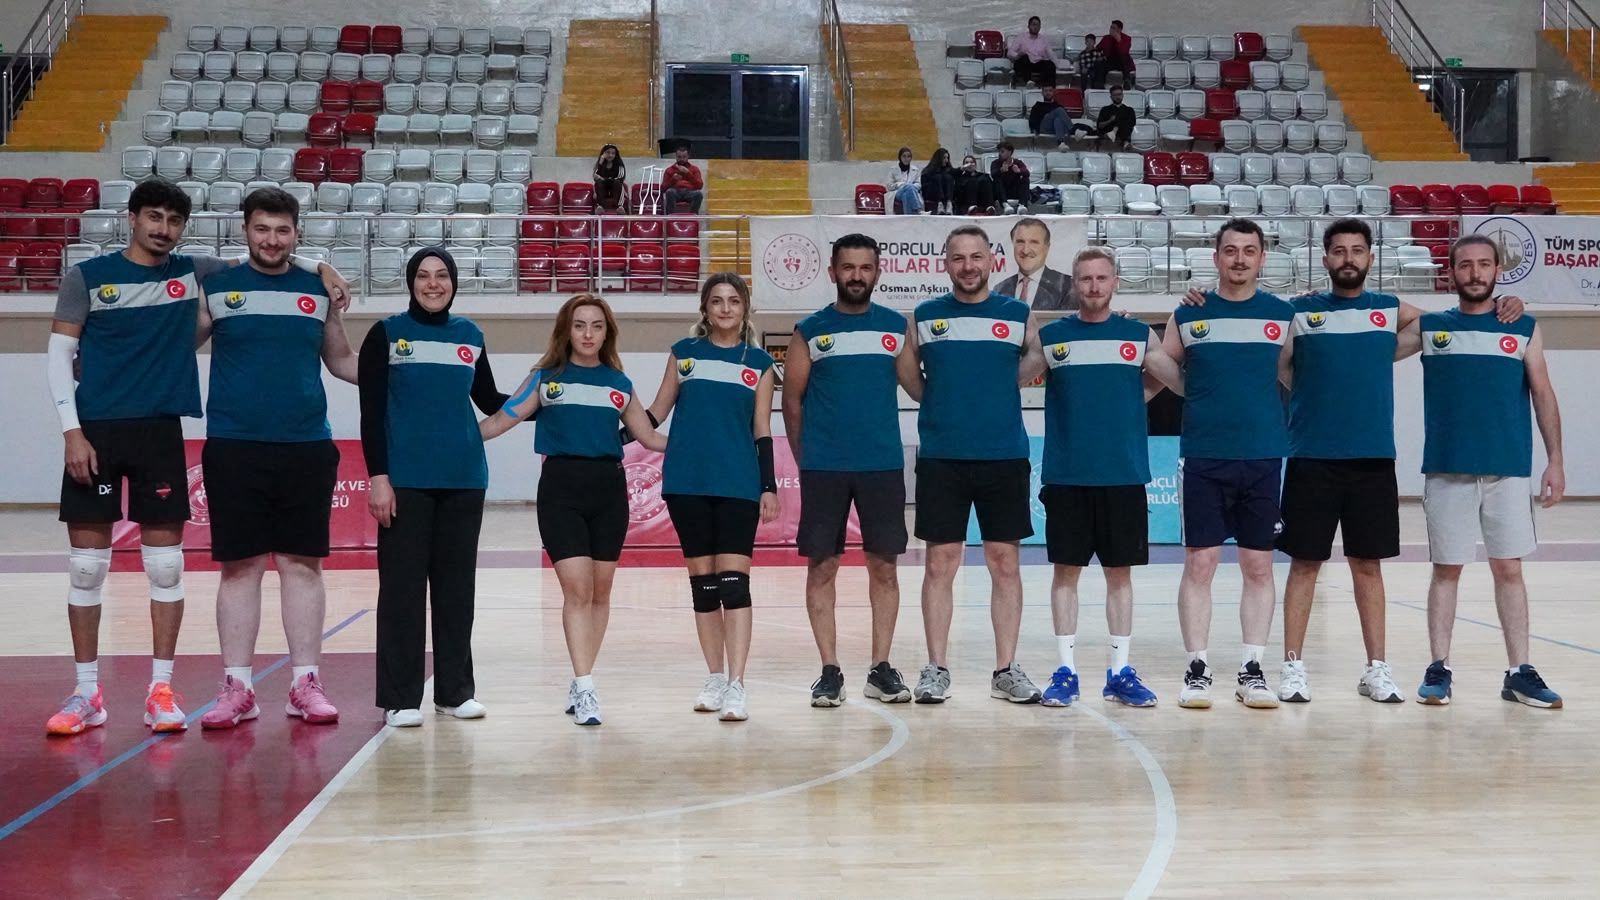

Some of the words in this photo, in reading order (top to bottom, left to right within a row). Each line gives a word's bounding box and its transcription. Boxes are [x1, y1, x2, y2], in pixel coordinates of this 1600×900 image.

[1545, 236, 1575, 251] TÜM
[1502, 238, 1533, 281] LEDİYESİ
[880, 258, 930, 273] RILAR
[880, 284, 917, 293] Osman
[919, 284, 950, 295] Aşkın
[1581, 279, 1596, 289] Dr.
[348, 480, 366, 491] VE
[775, 477, 791, 488] VE
